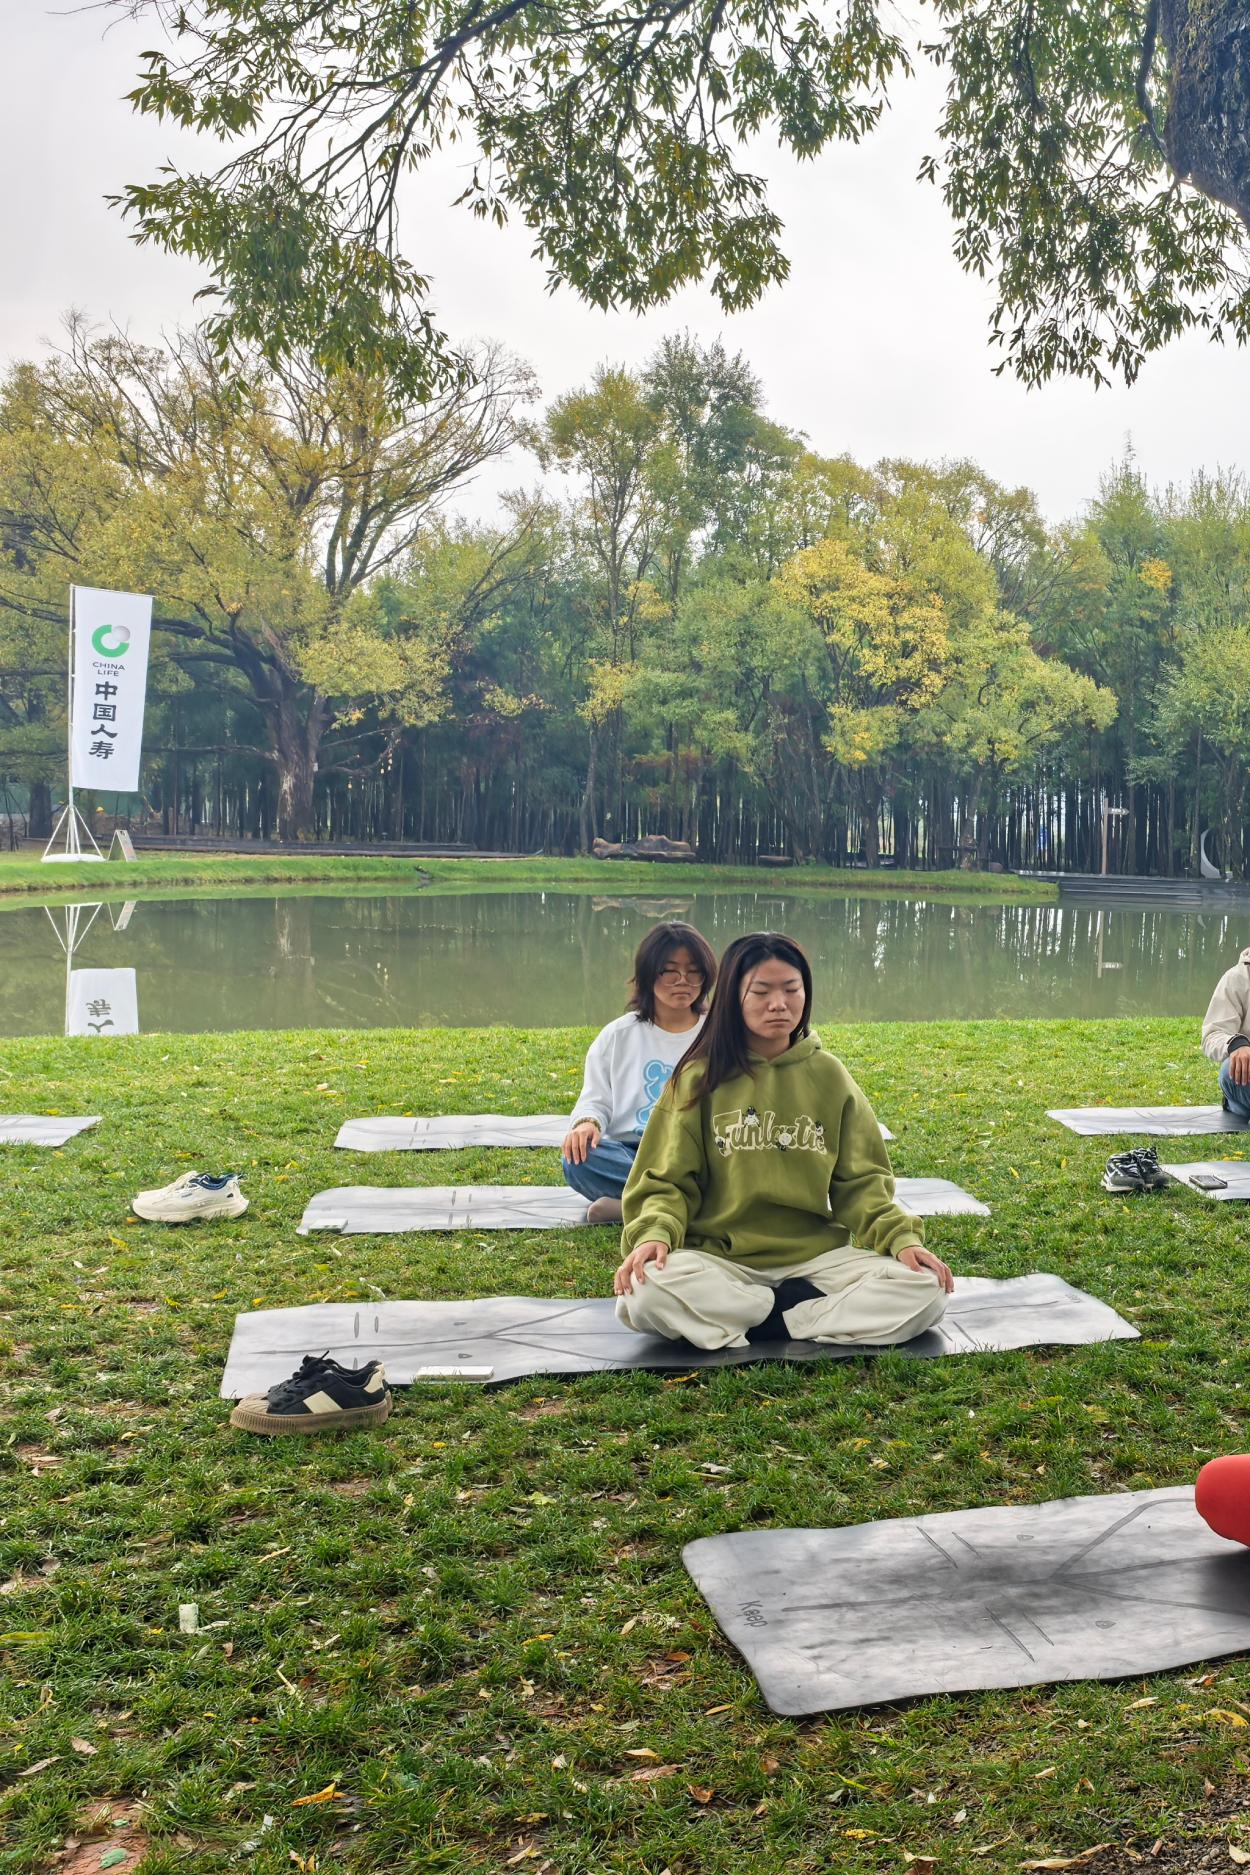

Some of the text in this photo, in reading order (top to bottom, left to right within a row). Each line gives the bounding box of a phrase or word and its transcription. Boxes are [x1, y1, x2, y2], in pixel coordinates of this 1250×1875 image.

[92, 661, 126, 671] CHINA
[97, 669, 119, 677] LIFE
[88, 681, 118, 760] 中国人寿
[736, 1600, 769, 1628] Keep
